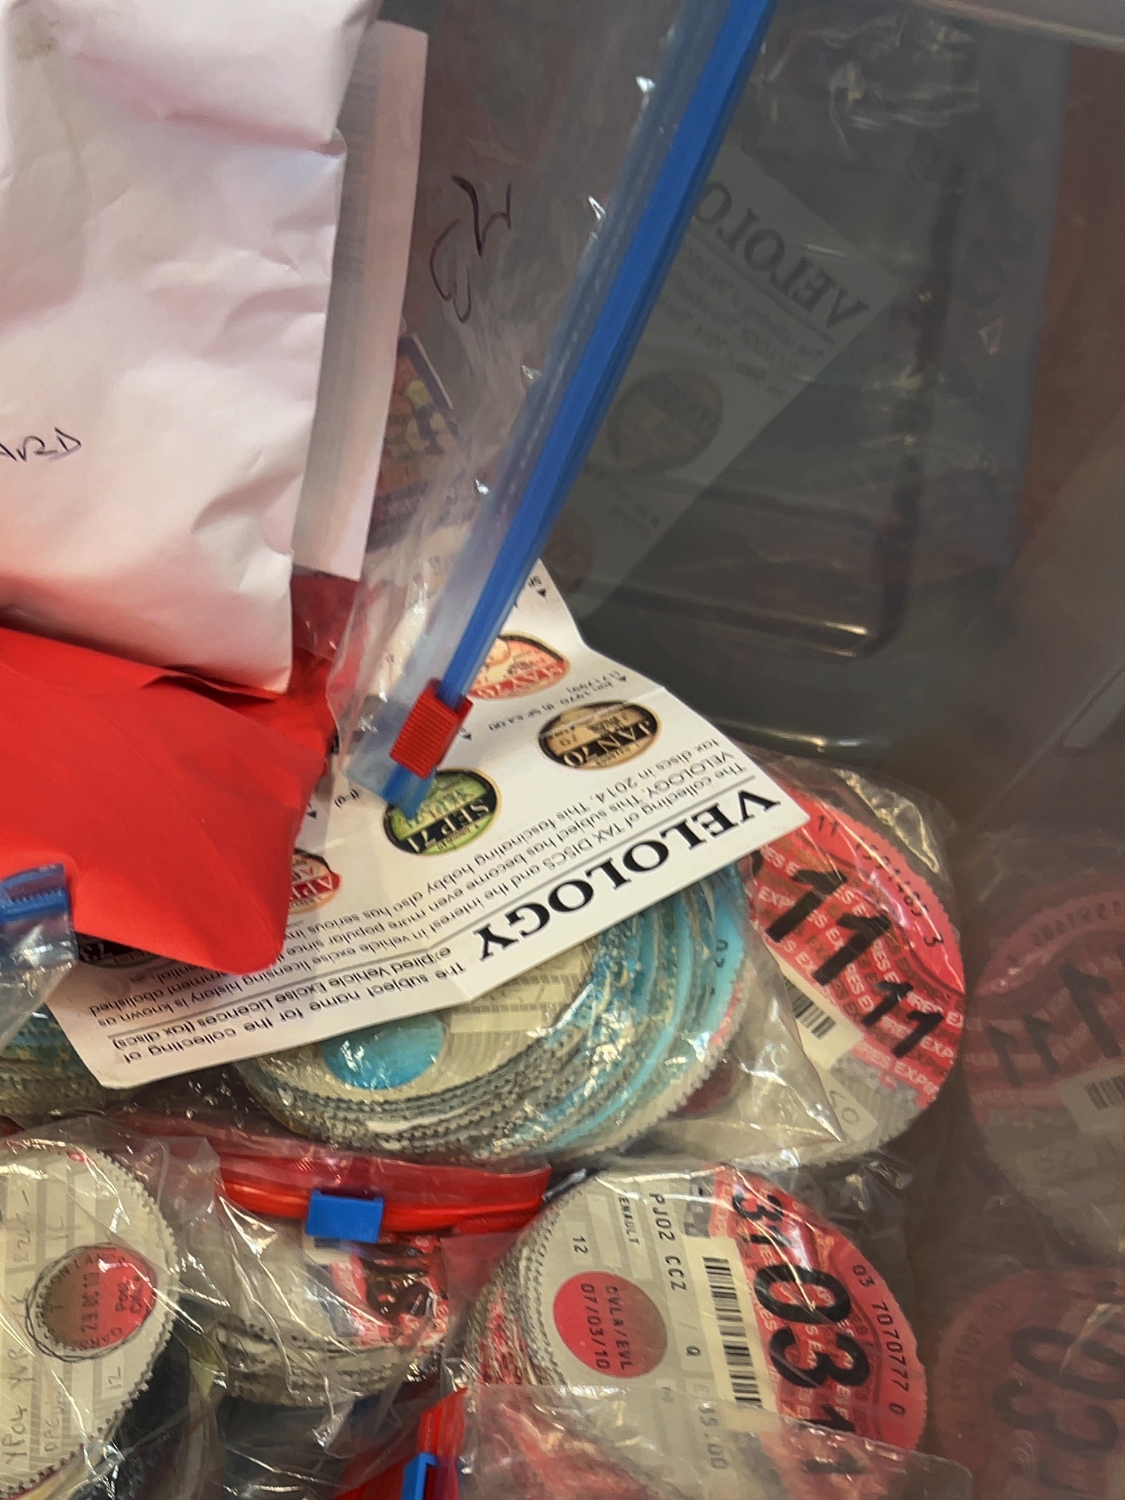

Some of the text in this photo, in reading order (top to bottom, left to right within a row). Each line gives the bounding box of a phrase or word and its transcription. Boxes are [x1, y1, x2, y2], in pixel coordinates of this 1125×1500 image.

[593, 715, 653, 758] JAN
[694, 736, 719, 756] tax
[561, 743, 594, 773] 70
[654, 746, 693, 775] discs
[713, 758, 746, 785] The
[636, 766, 655, 784] in
[608, 791, 644, 819] This
[640, 772, 714, 821] collecting
[436, 796, 491, 838] SEP
[553, 805, 610, 846] subject
[554, 798, 590, 825] This
[623, 811, 642, 829] of
[472, 815, 557, 870] fascinating
[590, 818, 626, 846] TAX
[525, 835, 556, 860] has
[540, 835, 592, 871] DISCS
[423, 860, 475, 898] hobby
[463, 852, 527, 894] become
[465, 775, 779, 963] VELOLOGY
[509, 863, 542, 888] and
[391, 889, 425, 915] also
[426, 886, 464, 913] even
[482, 880, 511, 904] the
[306, 912, 361, 937] serious
[362, 904, 392, 924] has
[386, 904, 427, 935] more
[427, 896, 484, 934] interest
[326, 920, 385, 946] popular
[357, 930, 411, 957] vehicle
[411, 927, 428, 944] in
[284, 938, 324, 958] since
[310, 946, 357, 969] excise
[241, 958, 311, 989] licensing
[327, 963, 390, 992] Vehicle
[88, 986, 164, 1018] abolished
[173, 996, 189, 1012] is
[189, 980, 243, 1009] history
[273, 981, 327, 1005] Excise
[97, 1015, 117, 1029] as
[119, 1000, 174, 1026] known
[123, 960, 465, 1063] The subject name for the collecting of
[195, 996, 273, 1029] Licences
[161, 1019, 195, 1039] (tax
[570, 1234, 589, 1256] 12
[647, 1190, 688, 1294] PJ02 CCZ
[574, 1280, 617, 1372] 07/03/10
[598, 1282, 639, 1371] DVLA/EVL
[747, 1248, 874, 1408] 03
[870, 1298, 914, 1395] 7070777
